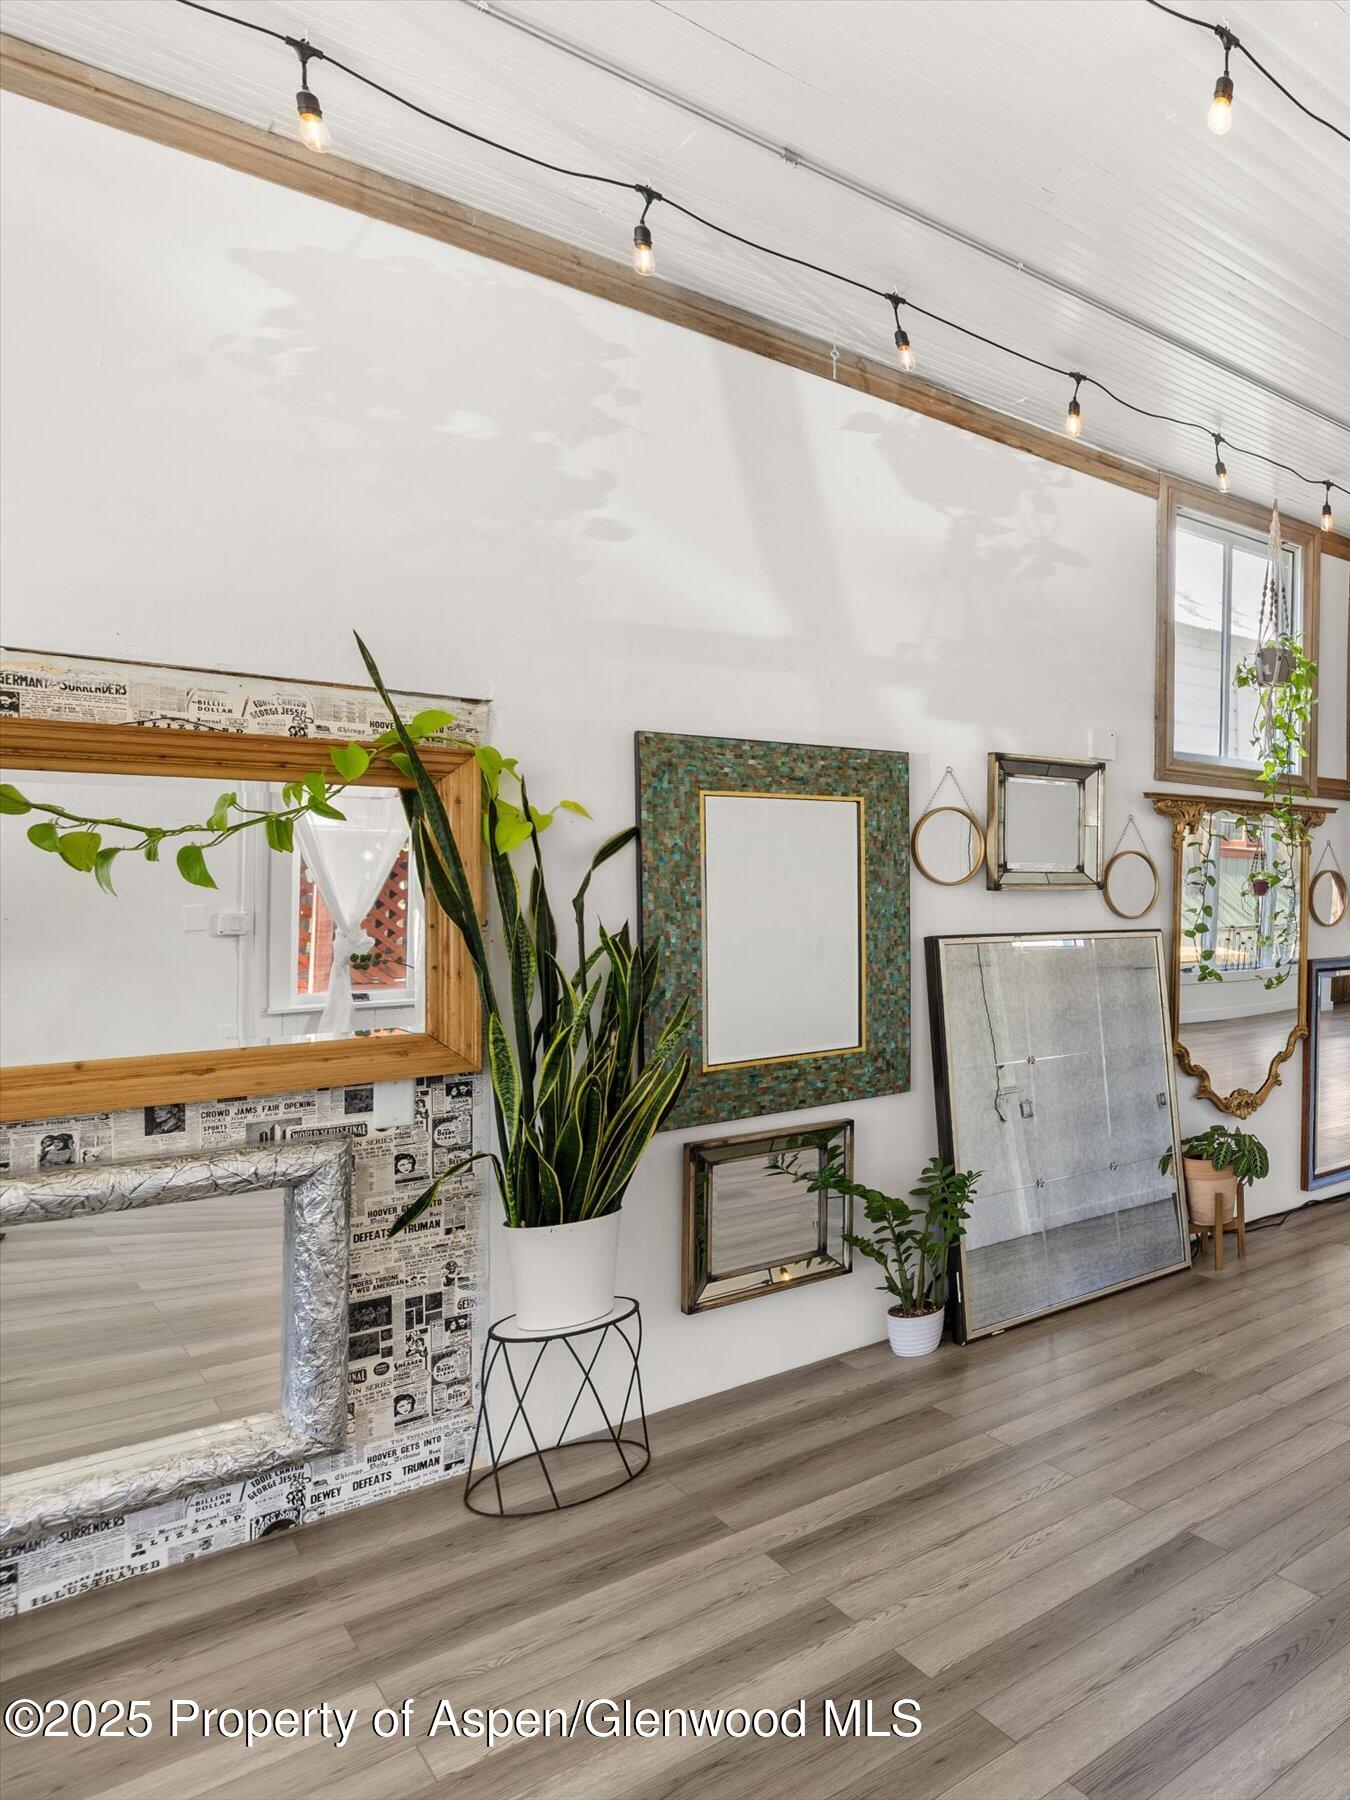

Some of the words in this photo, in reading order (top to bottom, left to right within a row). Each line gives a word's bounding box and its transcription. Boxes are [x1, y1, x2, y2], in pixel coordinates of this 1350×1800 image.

[197, 706, 233, 714] DOLLAR
[369, 720, 394, 730] HOOVE
[200, 1109, 230, 1119] CROWD
[234, 1106, 258, 1115] JAMS
[262, 1104, 280, 1112] FAIR
[284, 1100, 316, 1110] OPENING
[203, 1124, 228, 1132] SPORTS
[367, 1206, 397, 1219] HOOVER
[353, 1227, 393, 1243] DEFEATS
[372, 1278, 405, 1291] AMERICAN
[365, 1380, 393, 1391] SERIES
[367, 1449, 397, 1464] HOOVER
[401, 1443, 420, 1455] GETS
[424, 1435, 442, 1447] INTO
[310, 1486, 342, 1505] DEWEY
[352, 1471, 392, 1491] DEFEATS
[402, 1456, 441, 1476] TRUMAN
[248, 1481, 278, 1500] GEORGE
[195, 1492, 232, 1506] BILLION
[195, 1499, 231, 1513] DOLLAR
[58, 1515, 126, 1544] SURRENDERS
[135, 1515, 241, 1551] BLIZZARD
[32, 1559, 160, 1607] ILLUSTRATED
